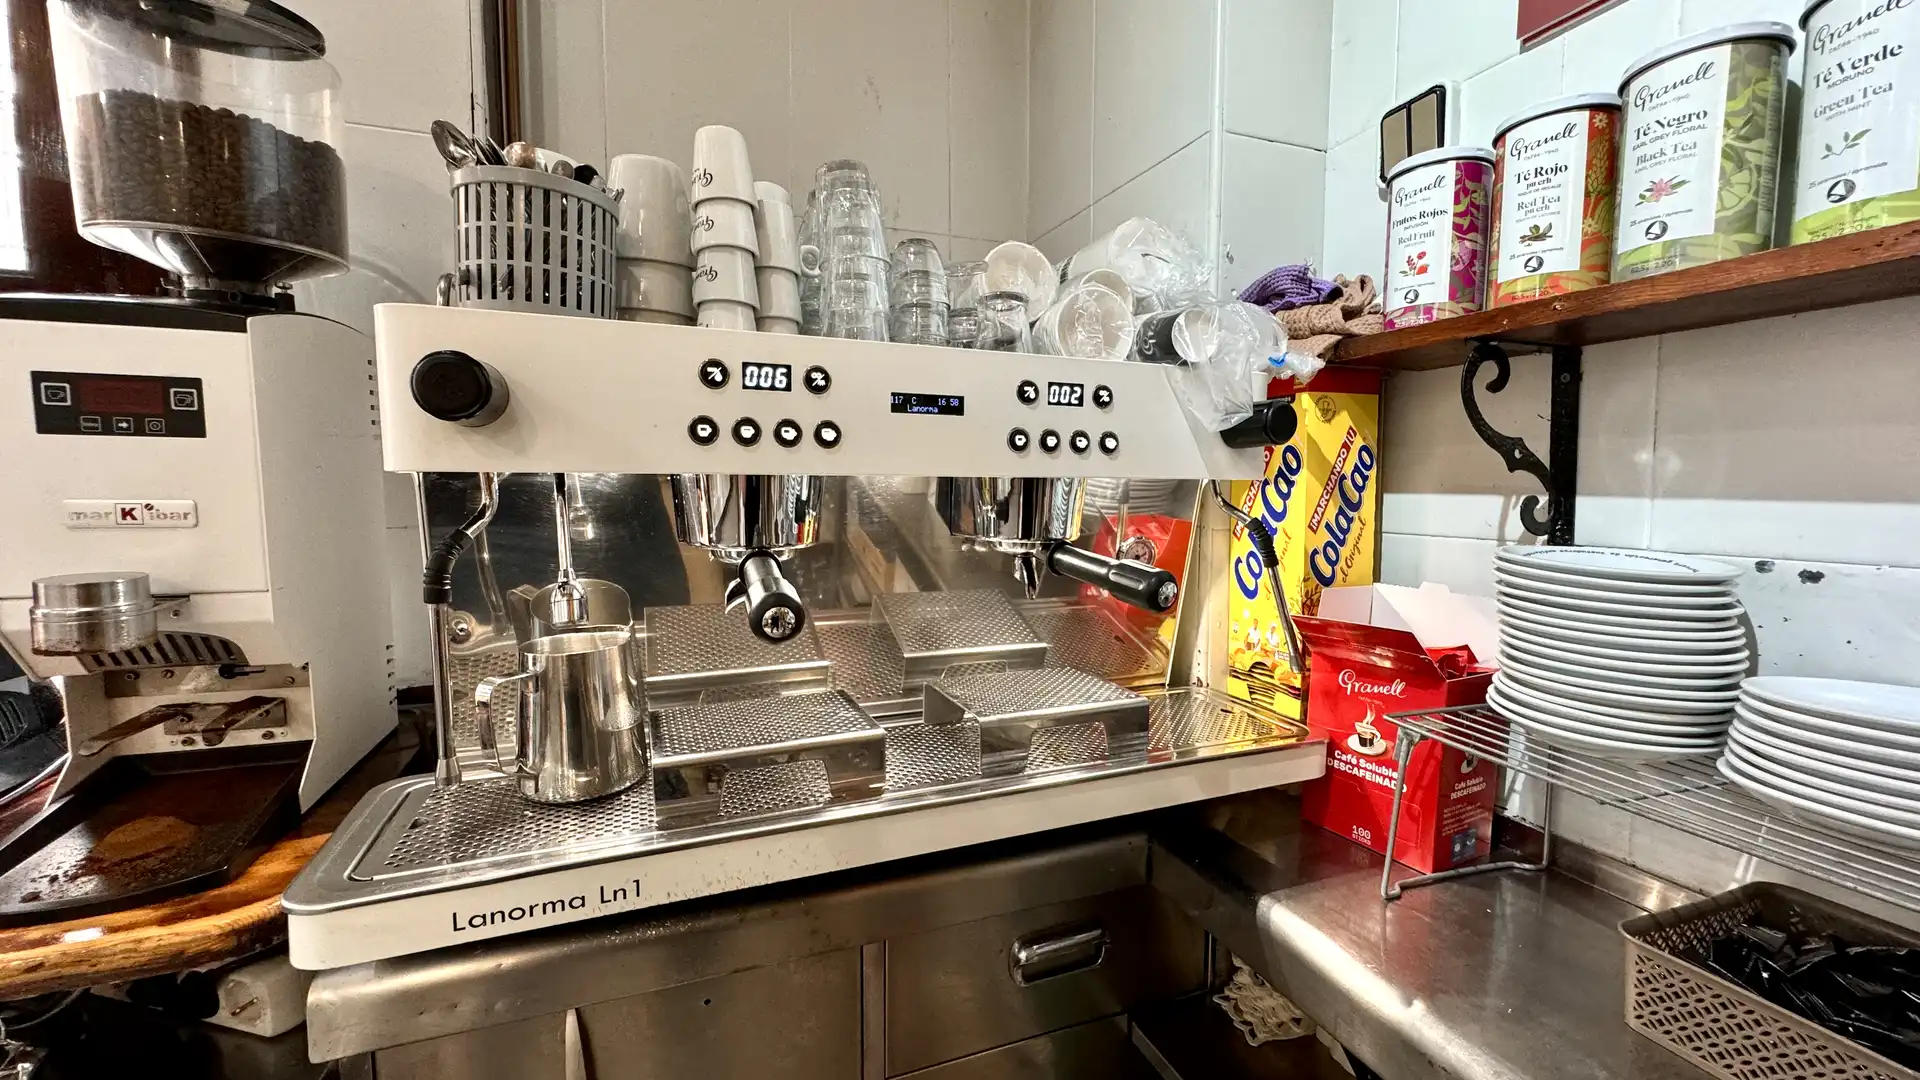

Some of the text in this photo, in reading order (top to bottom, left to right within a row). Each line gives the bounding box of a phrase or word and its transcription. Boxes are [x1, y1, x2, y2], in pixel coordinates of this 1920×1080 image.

[1813, 44, 1904, 89] Té Verde
[1827, 67, 1875, 90] MORUNO
[1634, 61, 1717, 112] Granell
[1814, 82, 1893, 119] Green Tea
[1632, 123, 1708, 152] EARL GREY FLORAL
[1634, 110, 1708, 141] Té Negro
[1510, 122, 1580, 161] Granell
[1636, 141, 1697, 166] Black Tea
[1514, 162, 1569, 184] Té Rojo
[1394, 174, 1447, 208] Granell
[1517, 195, 1561, 212] Red Tea
[1392, 208, 1449, 230] Frutos Rojos
[1397, 229, 1436, 246] Red Fruit
[744, 365, 788, 389] 006
[890, 395, 959, 406] 117 C 16 58
[1049, 385, 1082, 404] 002
[1234, 443, 1303, 600] CoCao
[1309, 444, 1375, 588] ColaCao
[1341, 516, 1367, 584] el Original
[1338, 668, 1409, 699] Granell
[1334, 750, 1399, 780] Café Soluble
[1450, 782, 1487, 800] DESCAFEINADO
[1454, 775, 1484, 790] Café Soluble
[1352, 824, 1372, 839] 100
[452, 879, 641, 932] Lanorma Ln1
